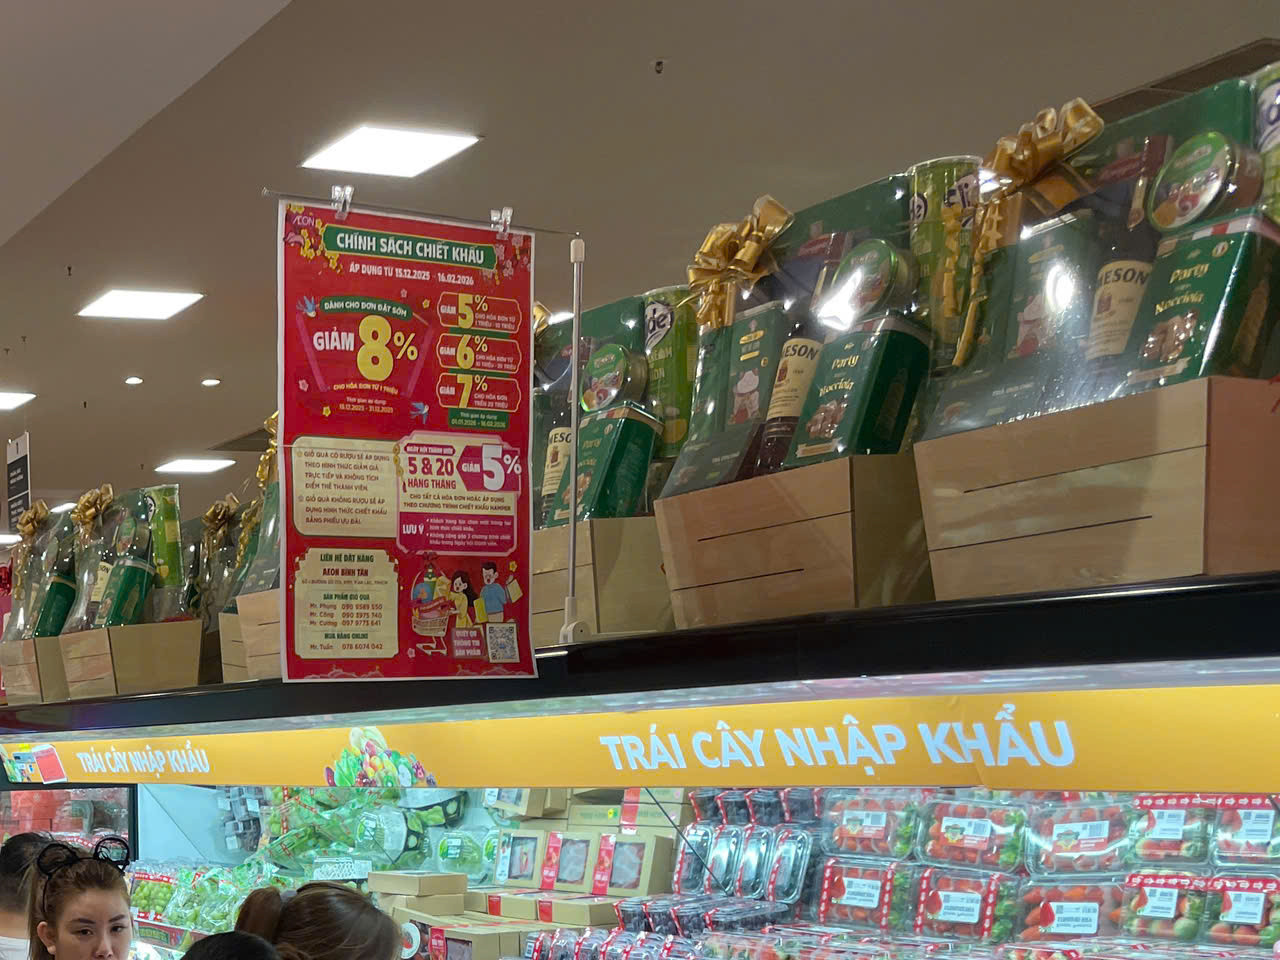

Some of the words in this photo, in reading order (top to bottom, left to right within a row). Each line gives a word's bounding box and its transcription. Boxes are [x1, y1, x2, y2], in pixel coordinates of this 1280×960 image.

[336, 231, 377, 251] CHÍNH
[380, 235, 413, 256] SÁCH
[416, 239, 450, 260] CHIẾT
[452, 244, 485, 265] KHẤU
[1098, 266, 1149, 285] ESON
[324, 300, 344, 310] DÀNH
[345, 301, 360, 309] CHO
[312, 325, 355, 352] GIẢM
[782, 342, 819, 361] ESON
[408, 456, 418, 475] 5
[421, 457, 433, 476] &
[435, 458, 455, 477] 20
[599, 723, 687, 770] TRÁI
[692, 719, 765, 768] CÂY
[774, 714, 907, 776] NHẬP
[917, 703, 1076, 767] KHẨU
[76, 746, 105, 773] TRÁI
[105, 745, 130, 773] CÂY
[129, 744, 167, 779] NHẬP
[167, 739, 211, 773] KHẨU
